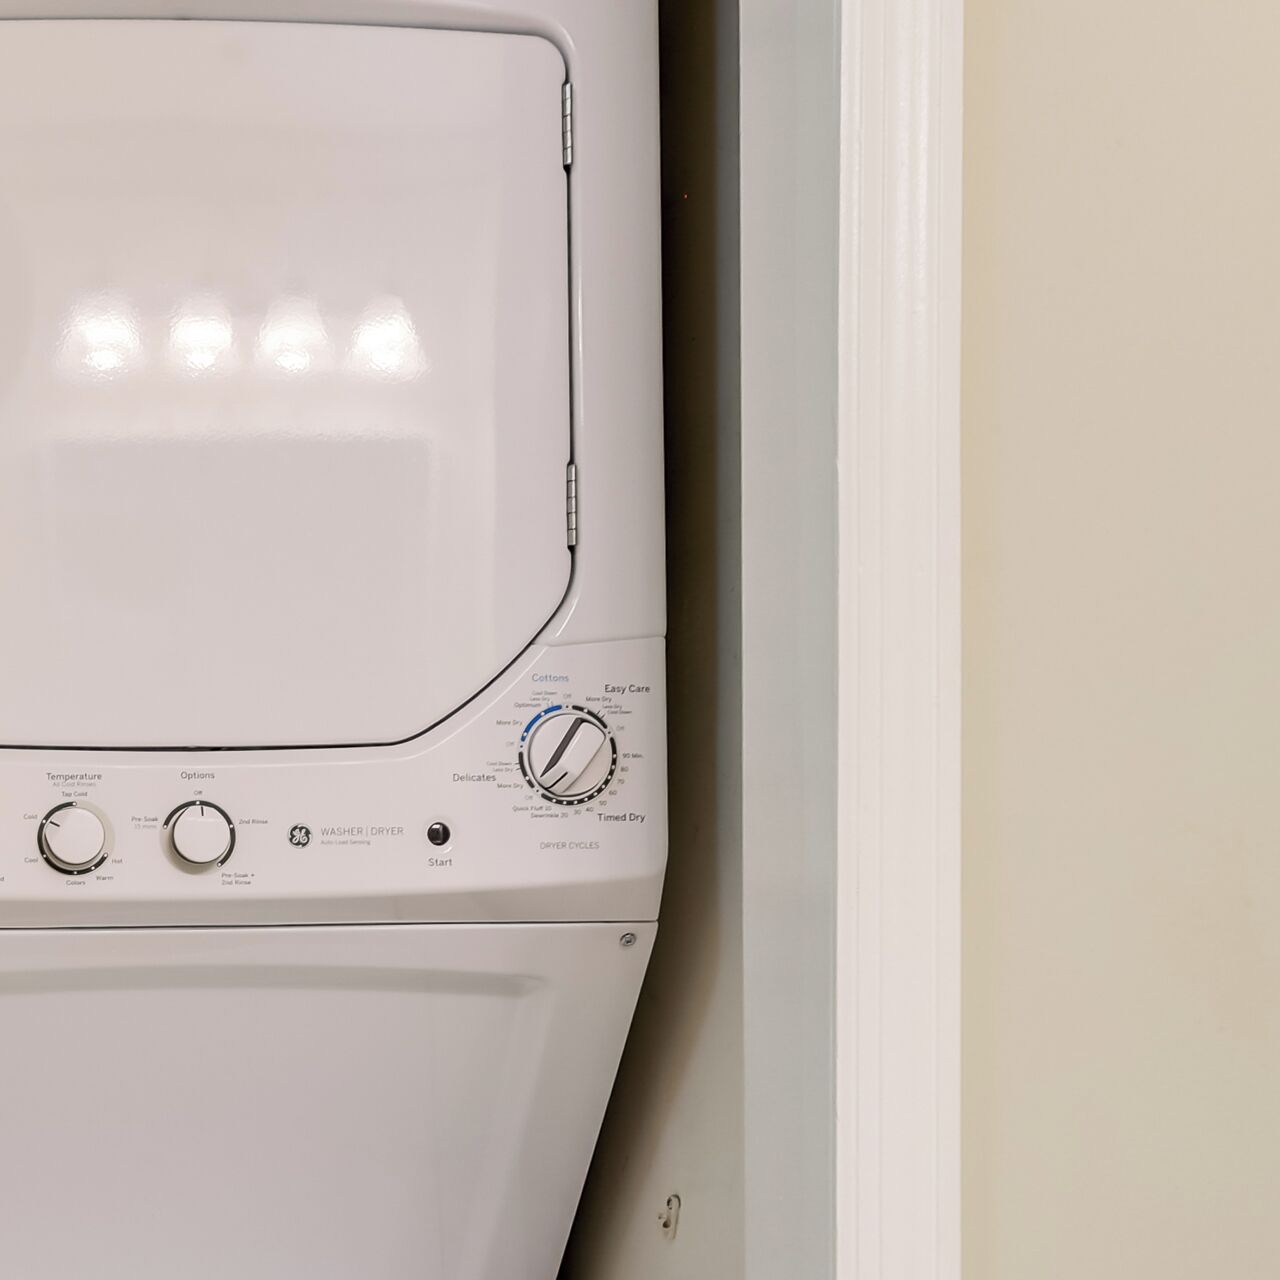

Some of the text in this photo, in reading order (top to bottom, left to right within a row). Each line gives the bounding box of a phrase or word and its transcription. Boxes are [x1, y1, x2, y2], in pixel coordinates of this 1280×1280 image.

[532, 673, 569, 682] Cottons
[604, 684, 650, 694] Easy Care
[46, 772, 102, 782] Temperature
[180, 771, 215, 780] Options
[453, 773, 497, 782] Delicates
[598, 813, 646, 823] Timed Dry
[321, 827, 404, 836] WASHER DRYER
[540, 841, 600, 850] DRYER CYCLES
[428, 858, 452, 867] Start
